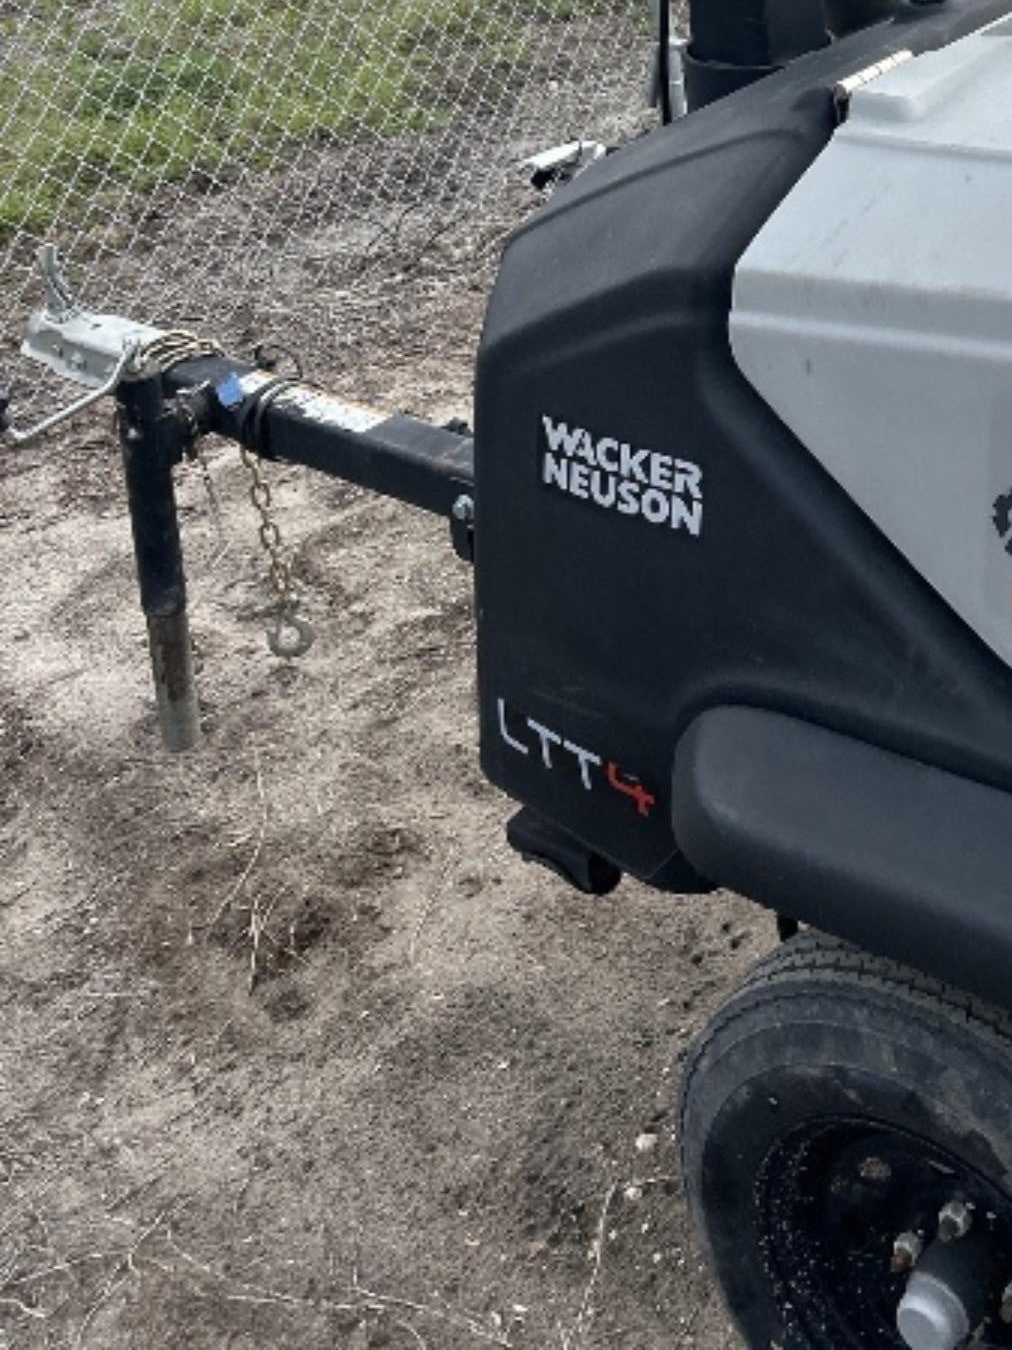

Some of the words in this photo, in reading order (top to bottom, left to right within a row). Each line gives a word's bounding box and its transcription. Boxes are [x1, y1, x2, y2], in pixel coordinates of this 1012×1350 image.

[542, 413, 703, 499] WACKER
[542, 452, 703, 537] NEUSON
[497, 697, 656, 818] LTT4
